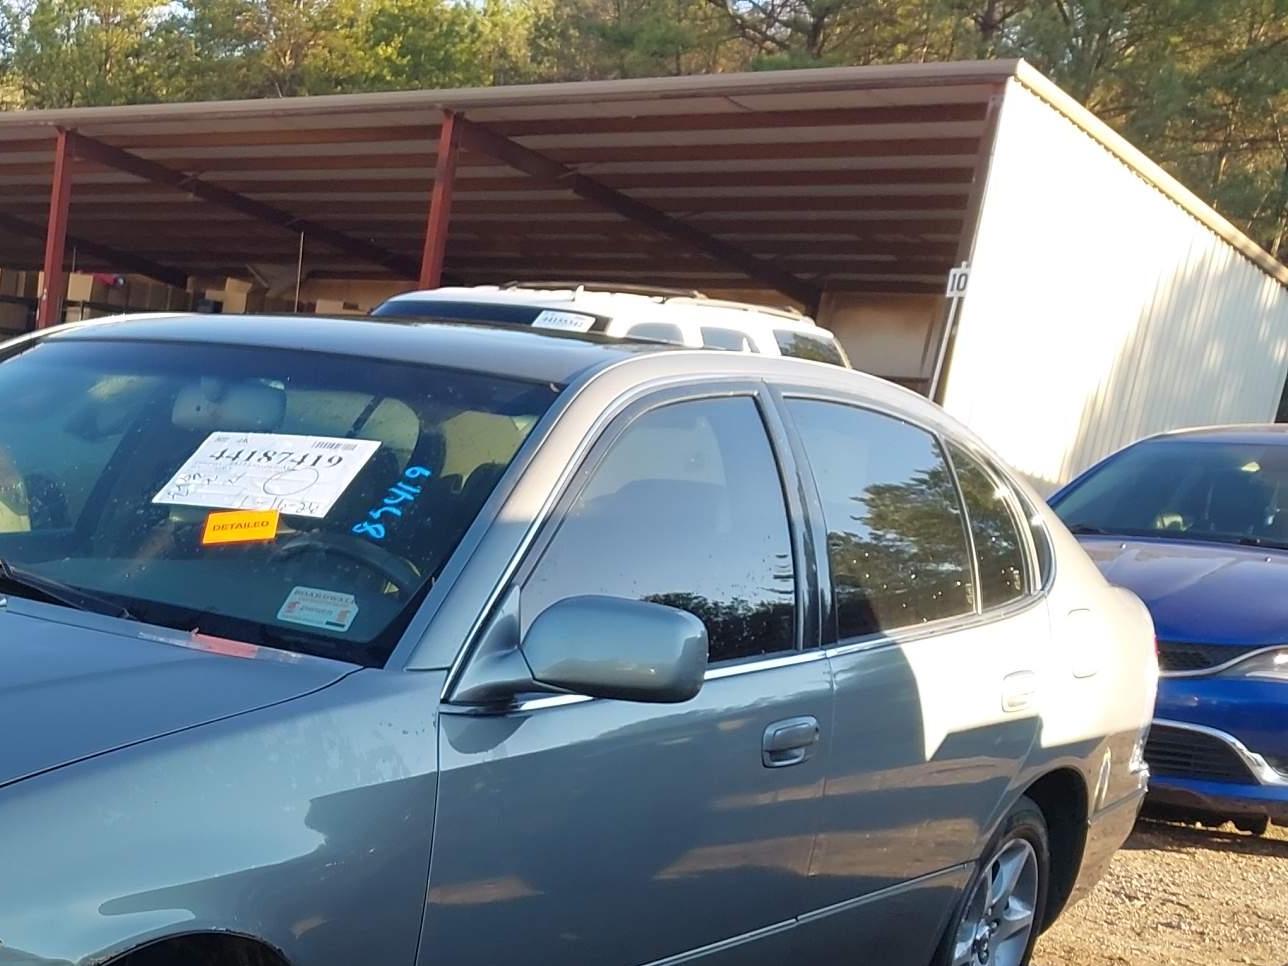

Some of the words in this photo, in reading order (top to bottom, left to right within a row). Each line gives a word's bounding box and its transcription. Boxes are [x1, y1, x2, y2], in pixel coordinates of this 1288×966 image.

[951, 273, 968, 291] 10
[210, 448, 343, 467] 44187419
[213, 520, 270, 531] DETAILED
